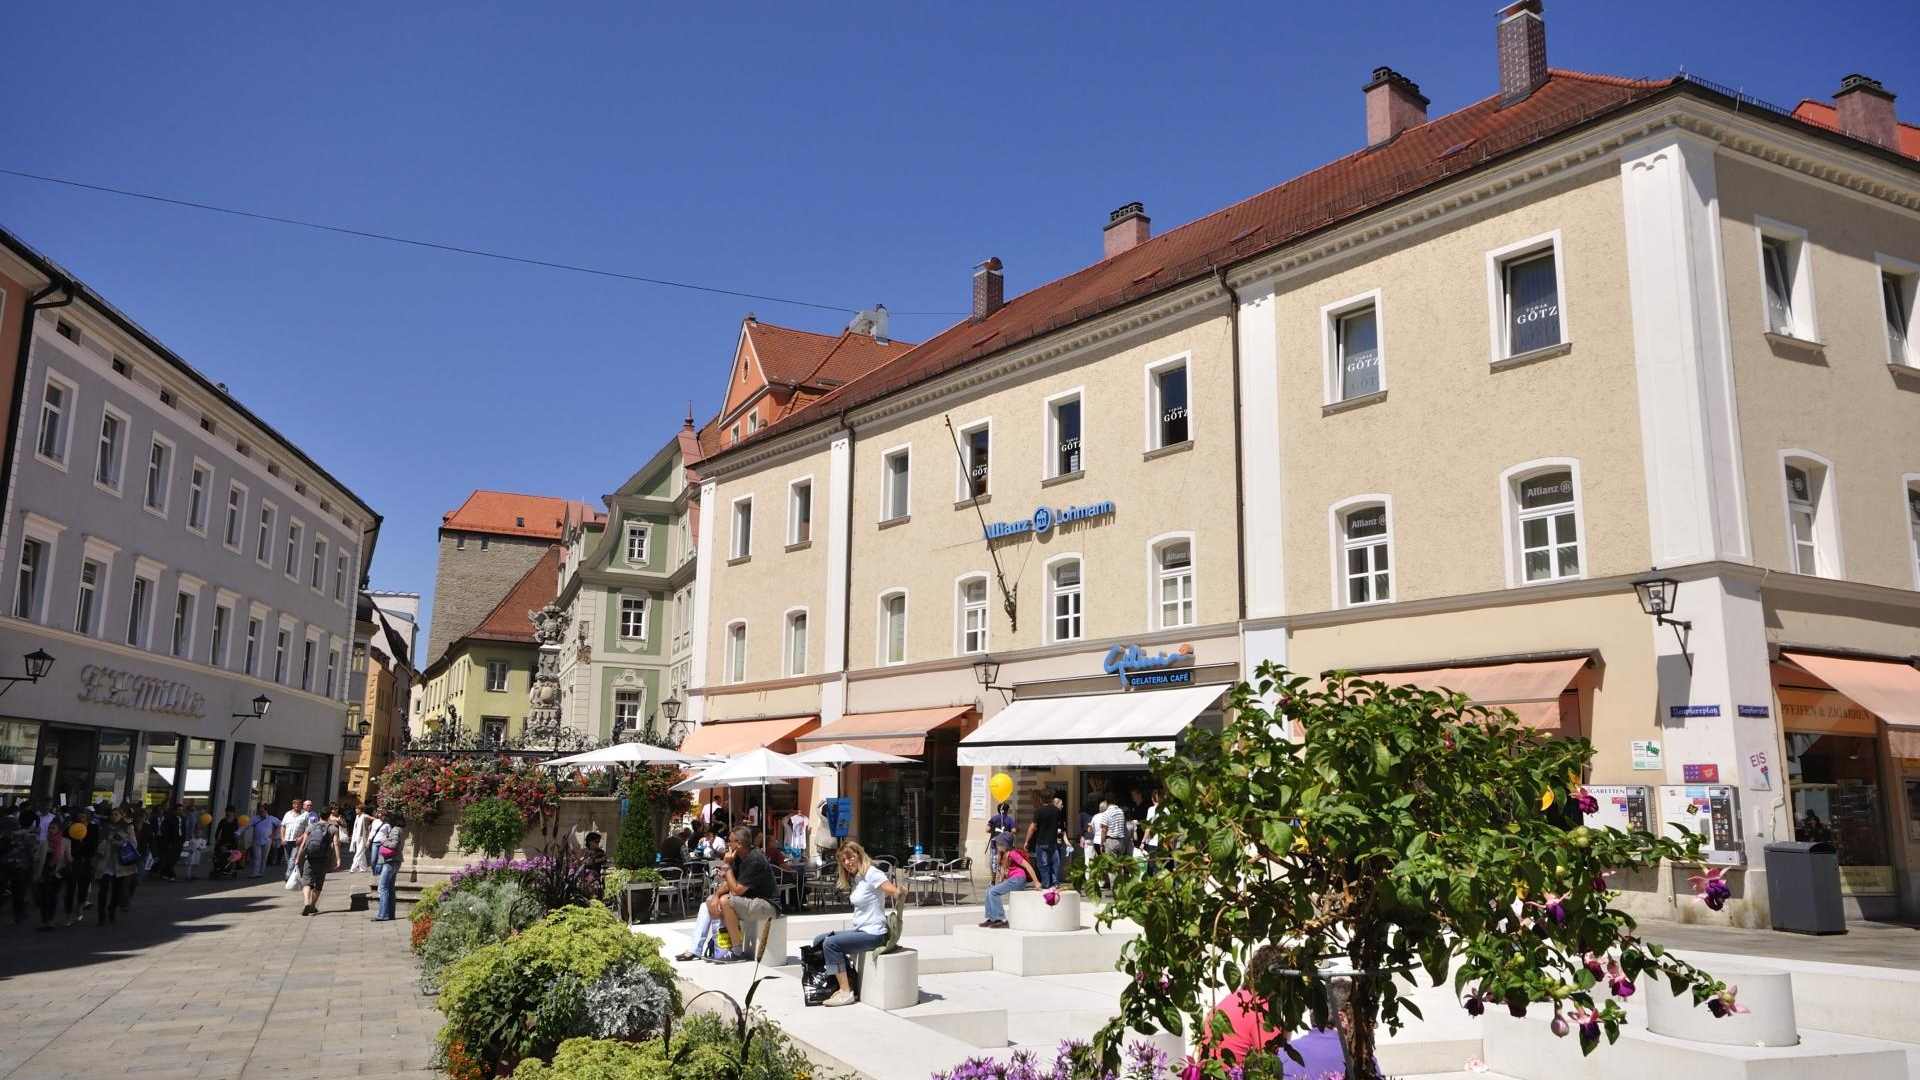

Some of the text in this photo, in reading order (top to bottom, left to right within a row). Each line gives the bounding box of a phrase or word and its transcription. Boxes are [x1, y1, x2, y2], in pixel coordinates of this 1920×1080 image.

[1517, 306, 1557, 324] GÖTZ
[1527, 485, 1560, 497] Allianz
[1055, 500, 1116, 524] Lohmann
[1351, 518, 1378, 529] Allianz
[1130, 672, 1190, 686] GELATERIA CAFÉ
[1750, 751, 1767, 768] EIS
